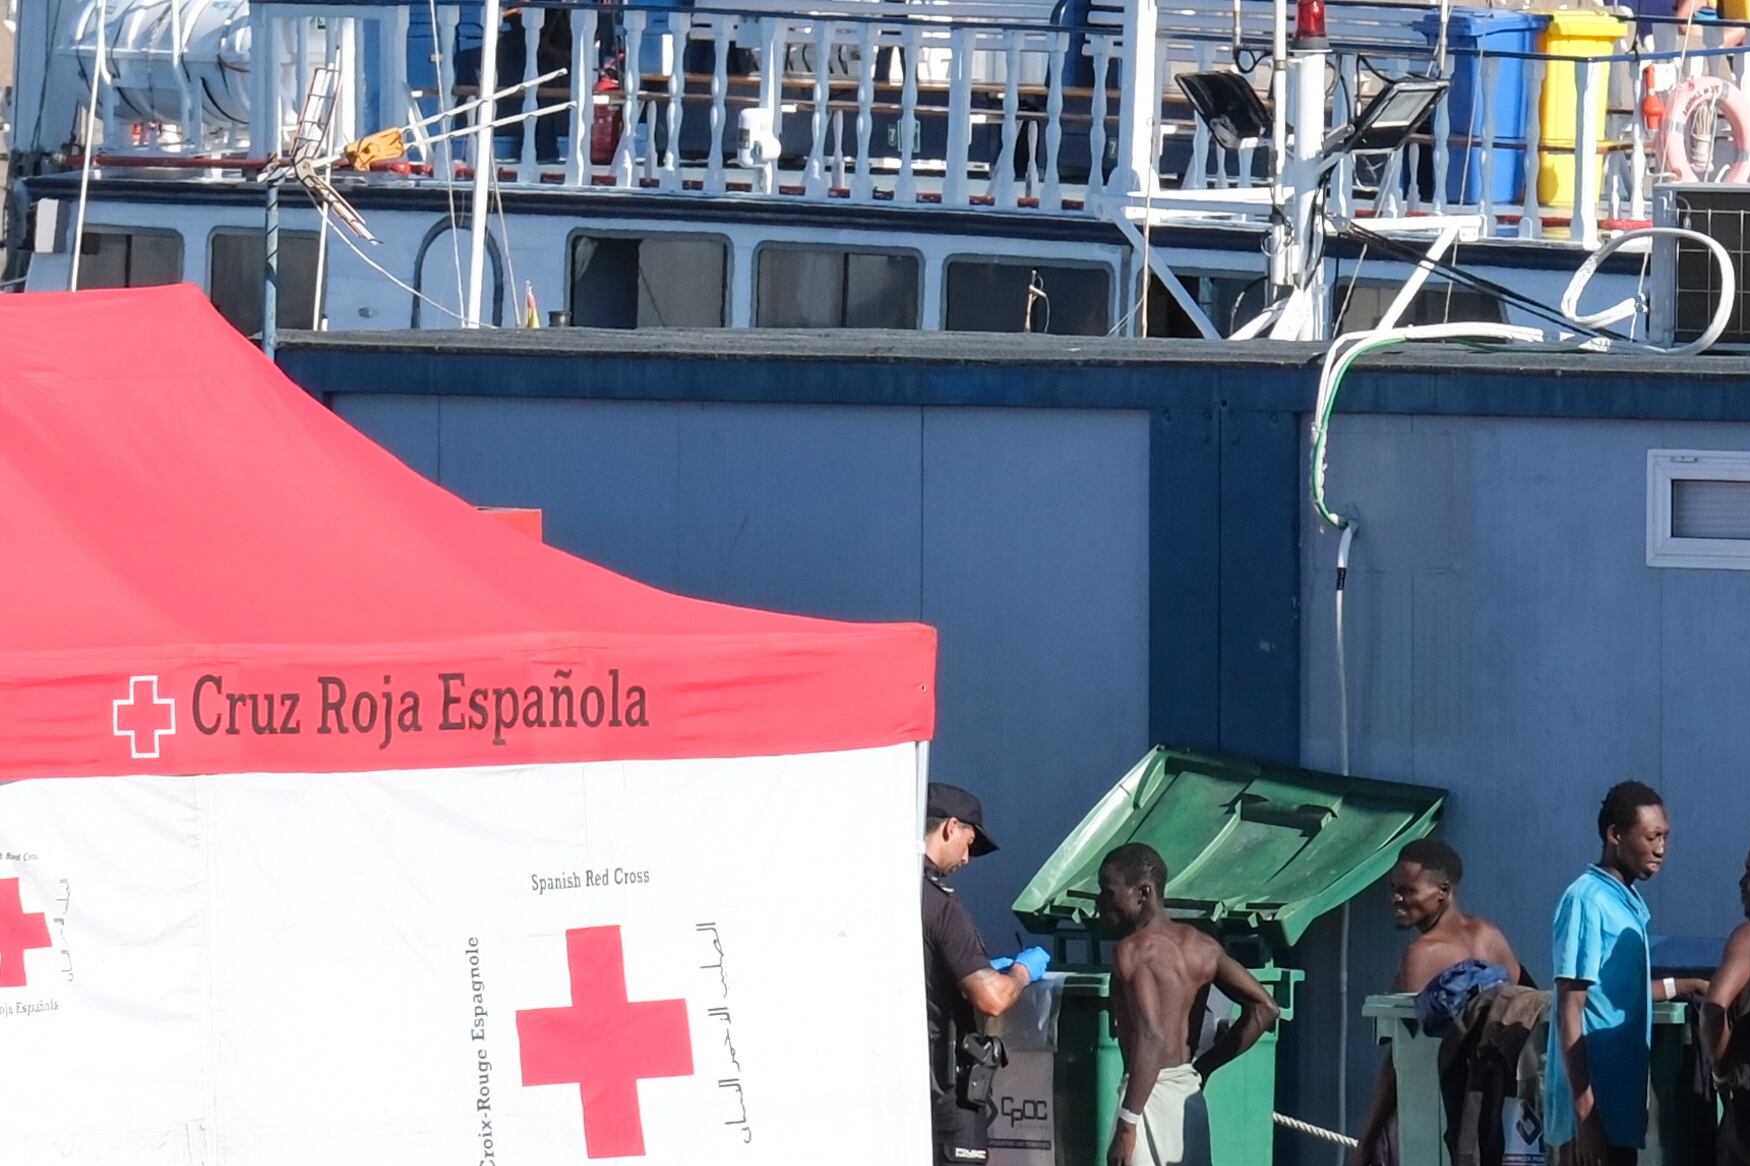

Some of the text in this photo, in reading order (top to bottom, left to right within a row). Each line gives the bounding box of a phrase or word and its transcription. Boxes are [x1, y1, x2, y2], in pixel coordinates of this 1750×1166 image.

[191, 669, 650, 750] Cruz Roja Española
[531, 866, 651, 896] Spanish Red Cross
[465, 936, 488, 1042] Espagnole
